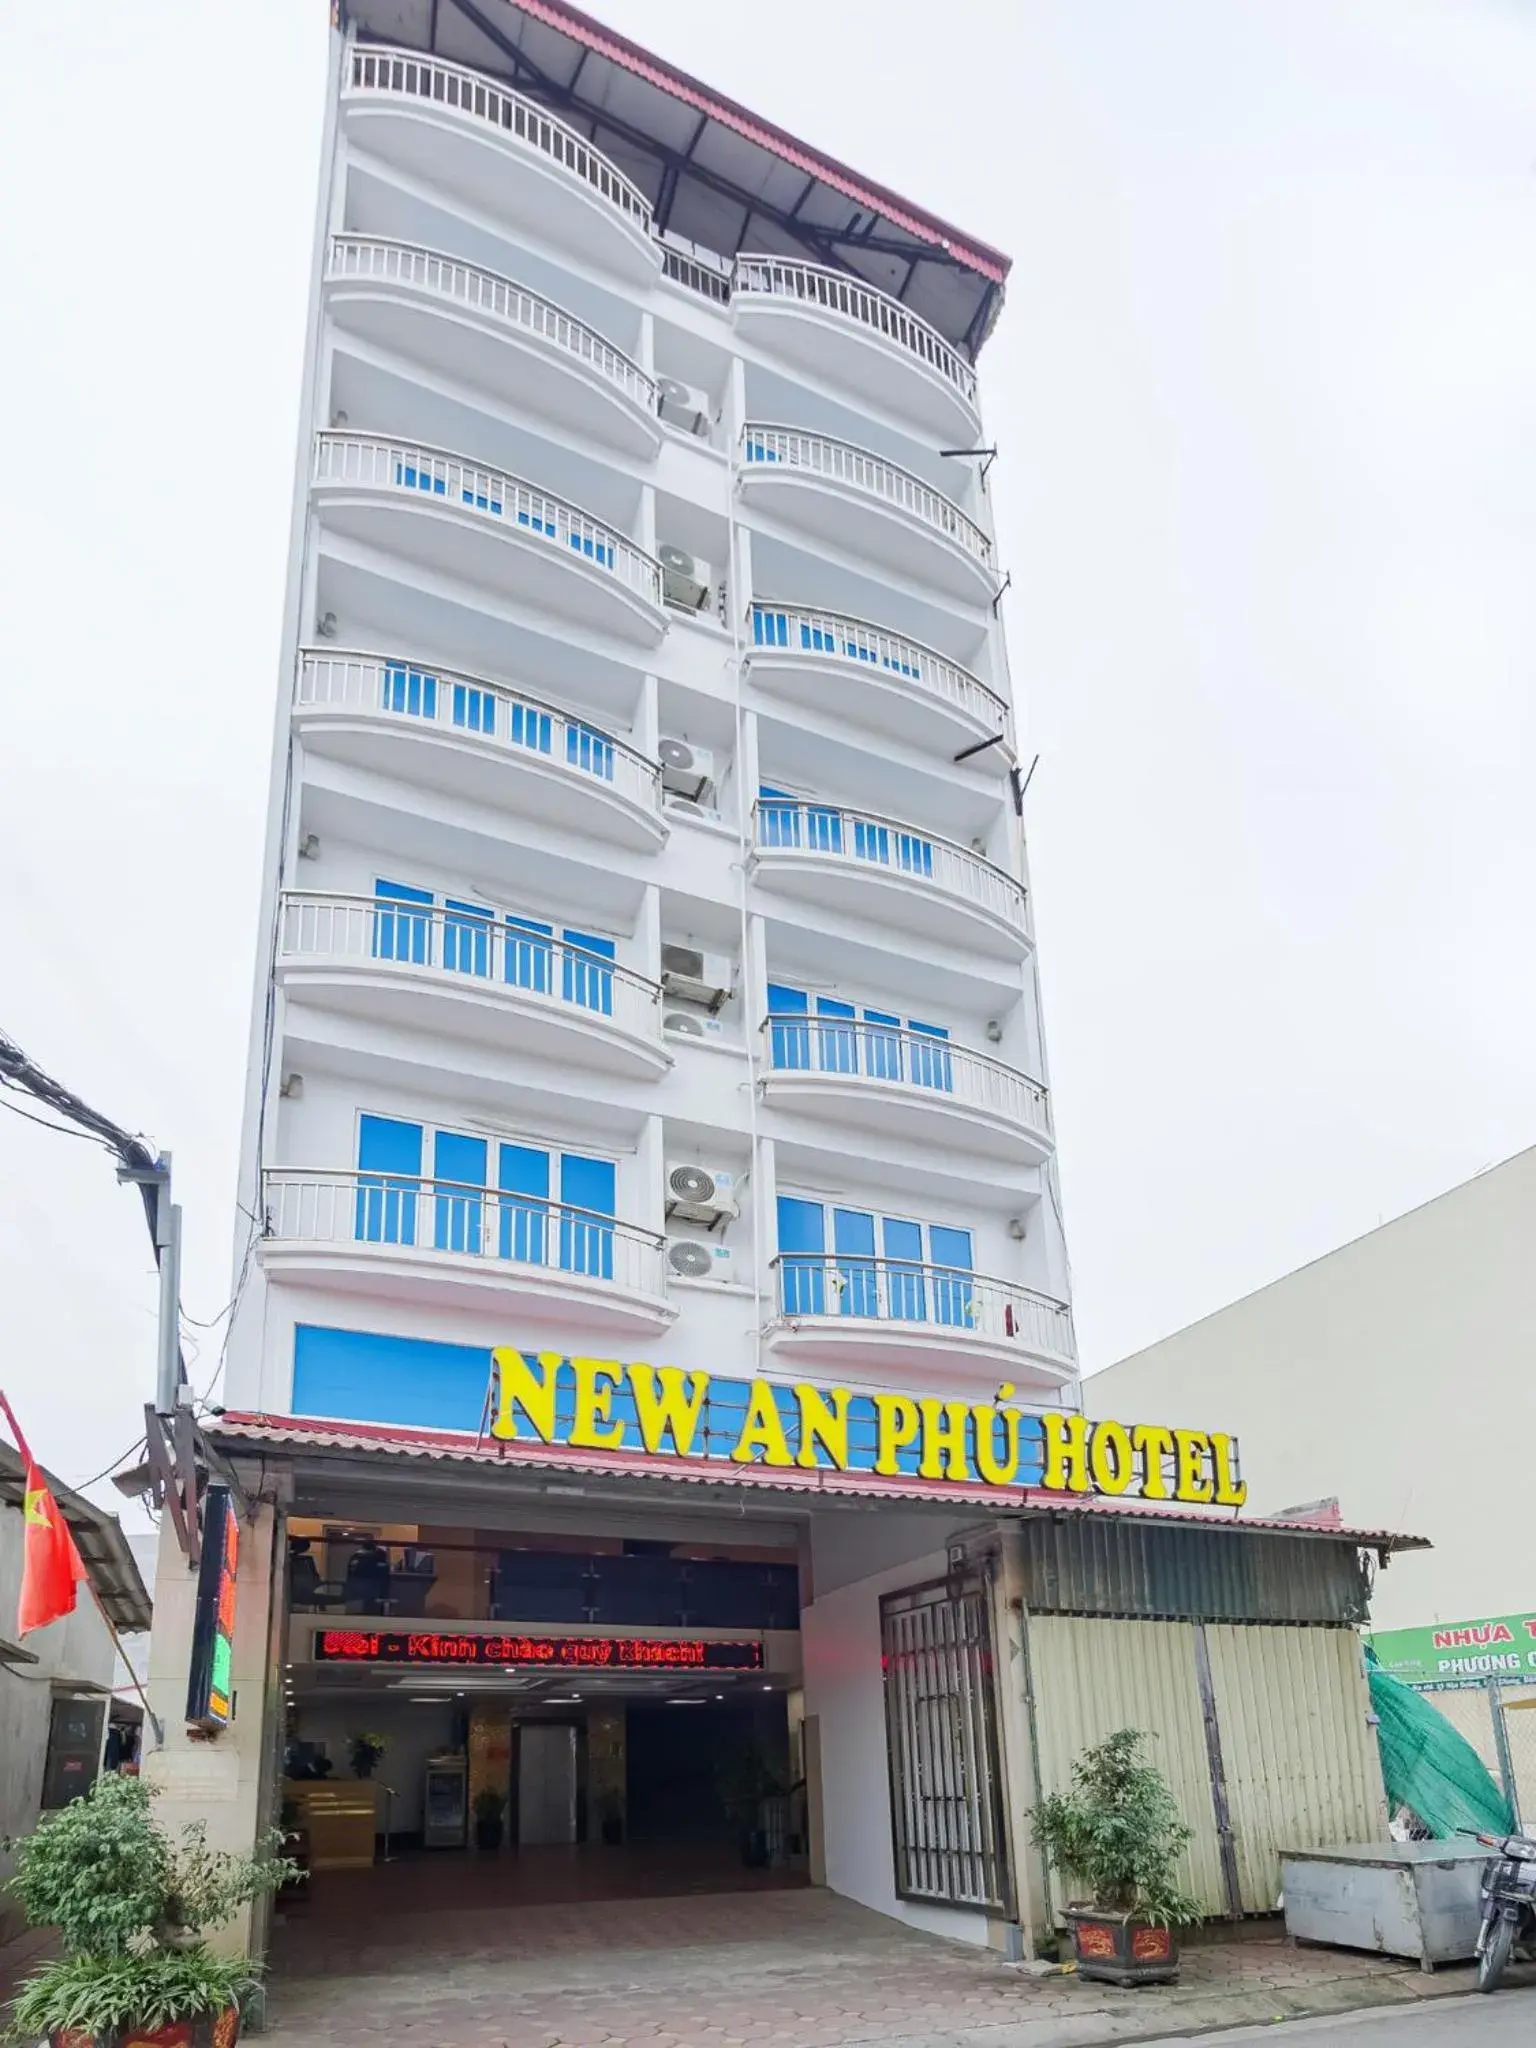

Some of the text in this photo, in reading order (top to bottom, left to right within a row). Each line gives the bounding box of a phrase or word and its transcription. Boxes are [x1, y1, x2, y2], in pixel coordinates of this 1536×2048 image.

[492, 1345, 1249, 1507] NEW AN PHÚ HOTEL
[1433, 1623, 1514, 1649] NHỰA
